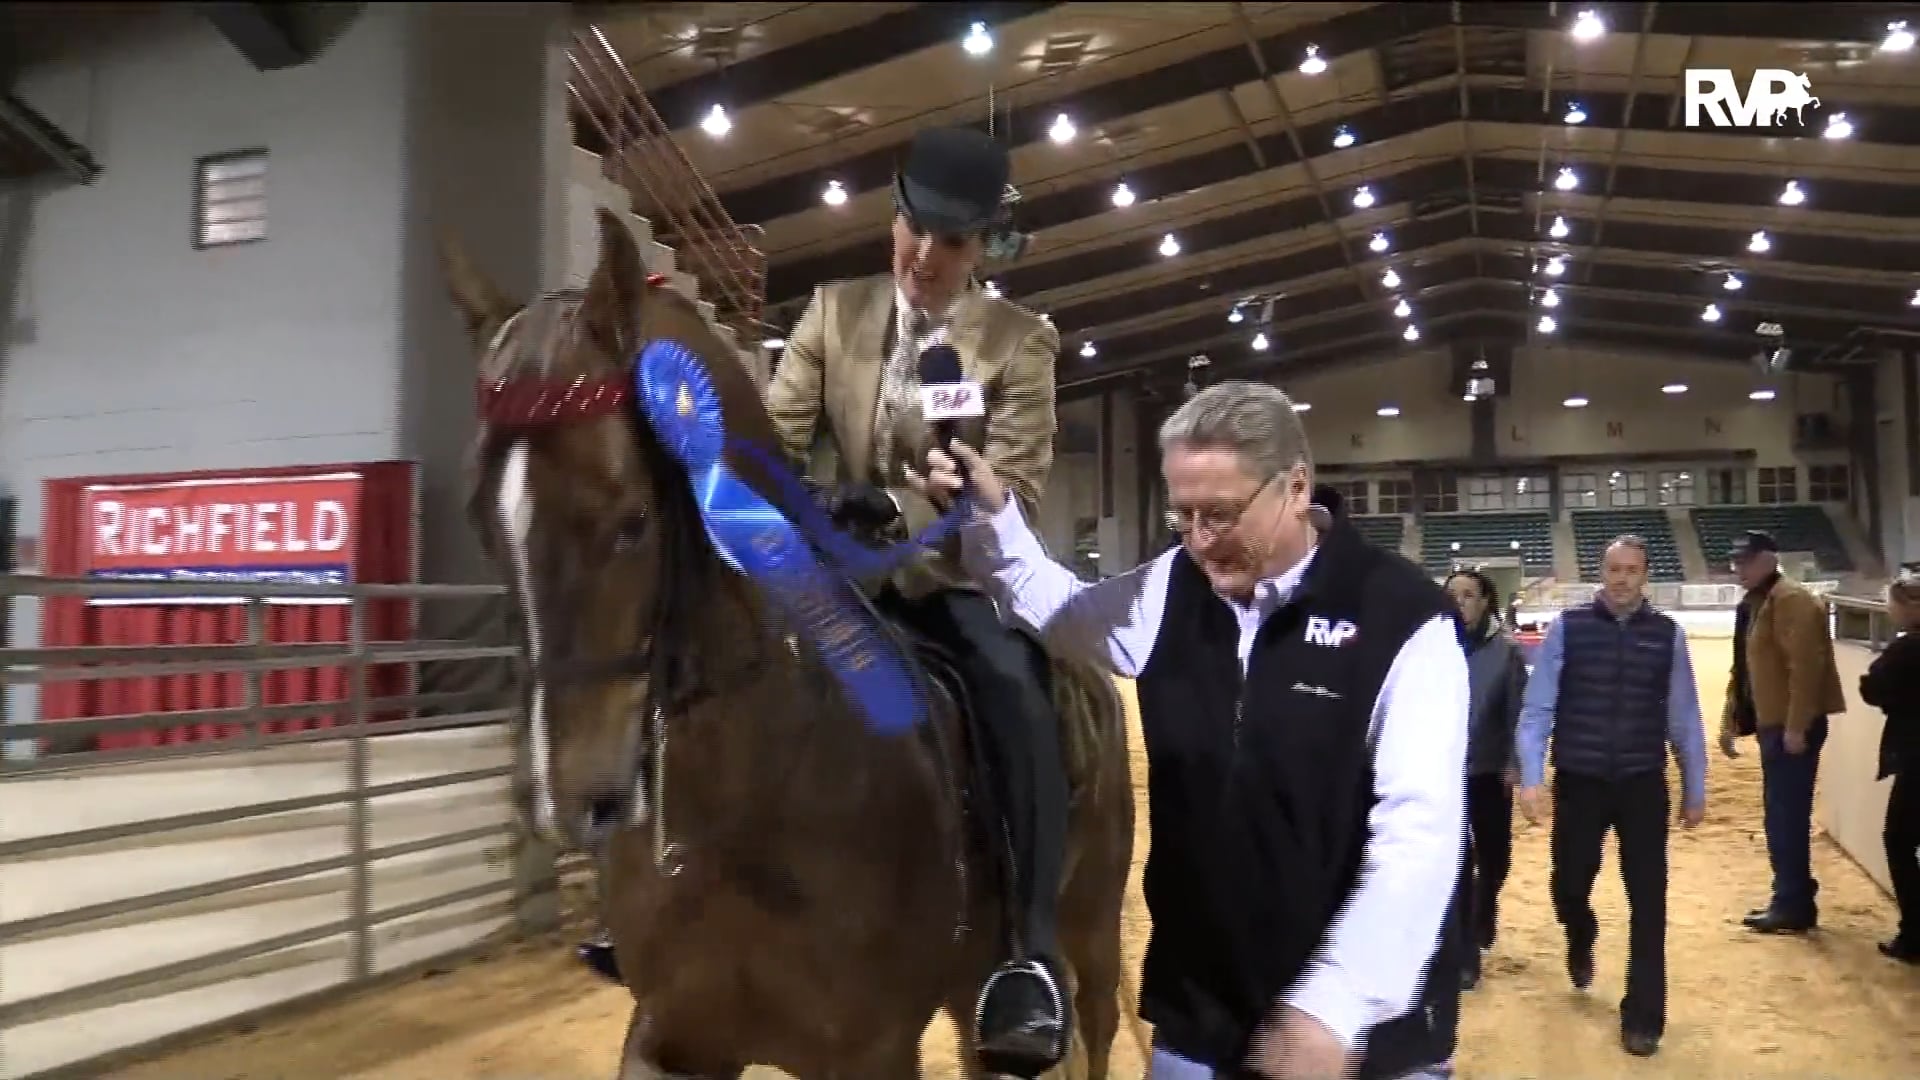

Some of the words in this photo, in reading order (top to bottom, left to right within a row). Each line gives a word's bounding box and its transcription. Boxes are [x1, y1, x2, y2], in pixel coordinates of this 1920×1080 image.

[932, 388, 971, 410] RVP
[1511, 425, 1524, 442] L
[1607, 421, 1624, 438] M
[1704, 417, 1721, 436] N
[92, 499, 349, 556] RICHFIELD
[1304, 615, 1357, 647] RVP
